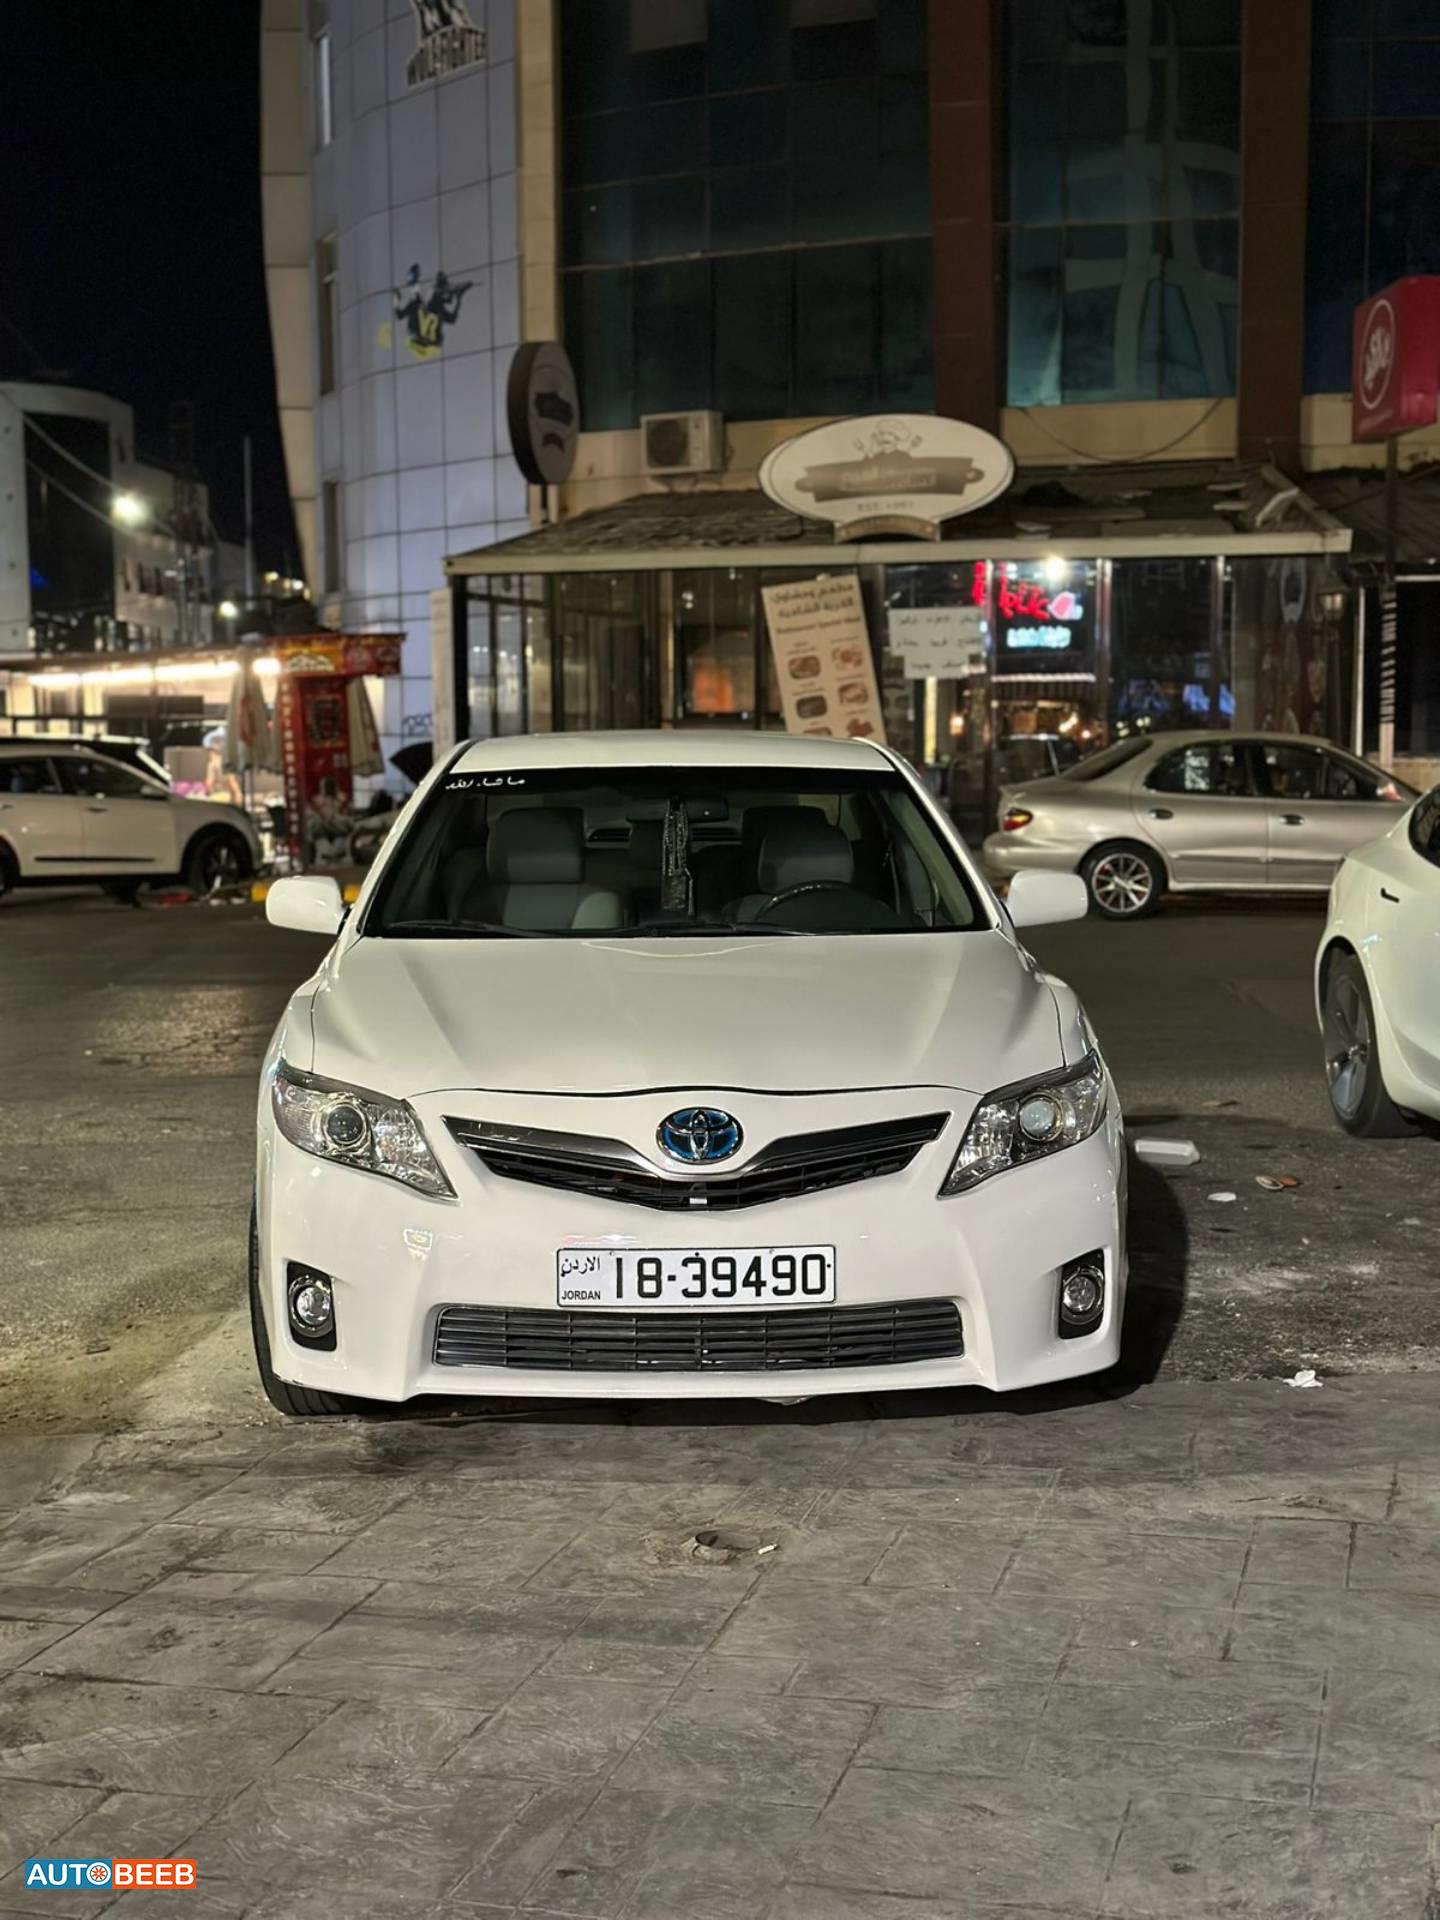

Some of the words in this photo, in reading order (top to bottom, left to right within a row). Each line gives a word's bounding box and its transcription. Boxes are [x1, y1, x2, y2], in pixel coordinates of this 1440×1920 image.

[560, 1256, 601, 1277] الاردن
[615, 1253, 827, 1299] 18-39490
[561, 1290, 601, 1300] JORDAN
